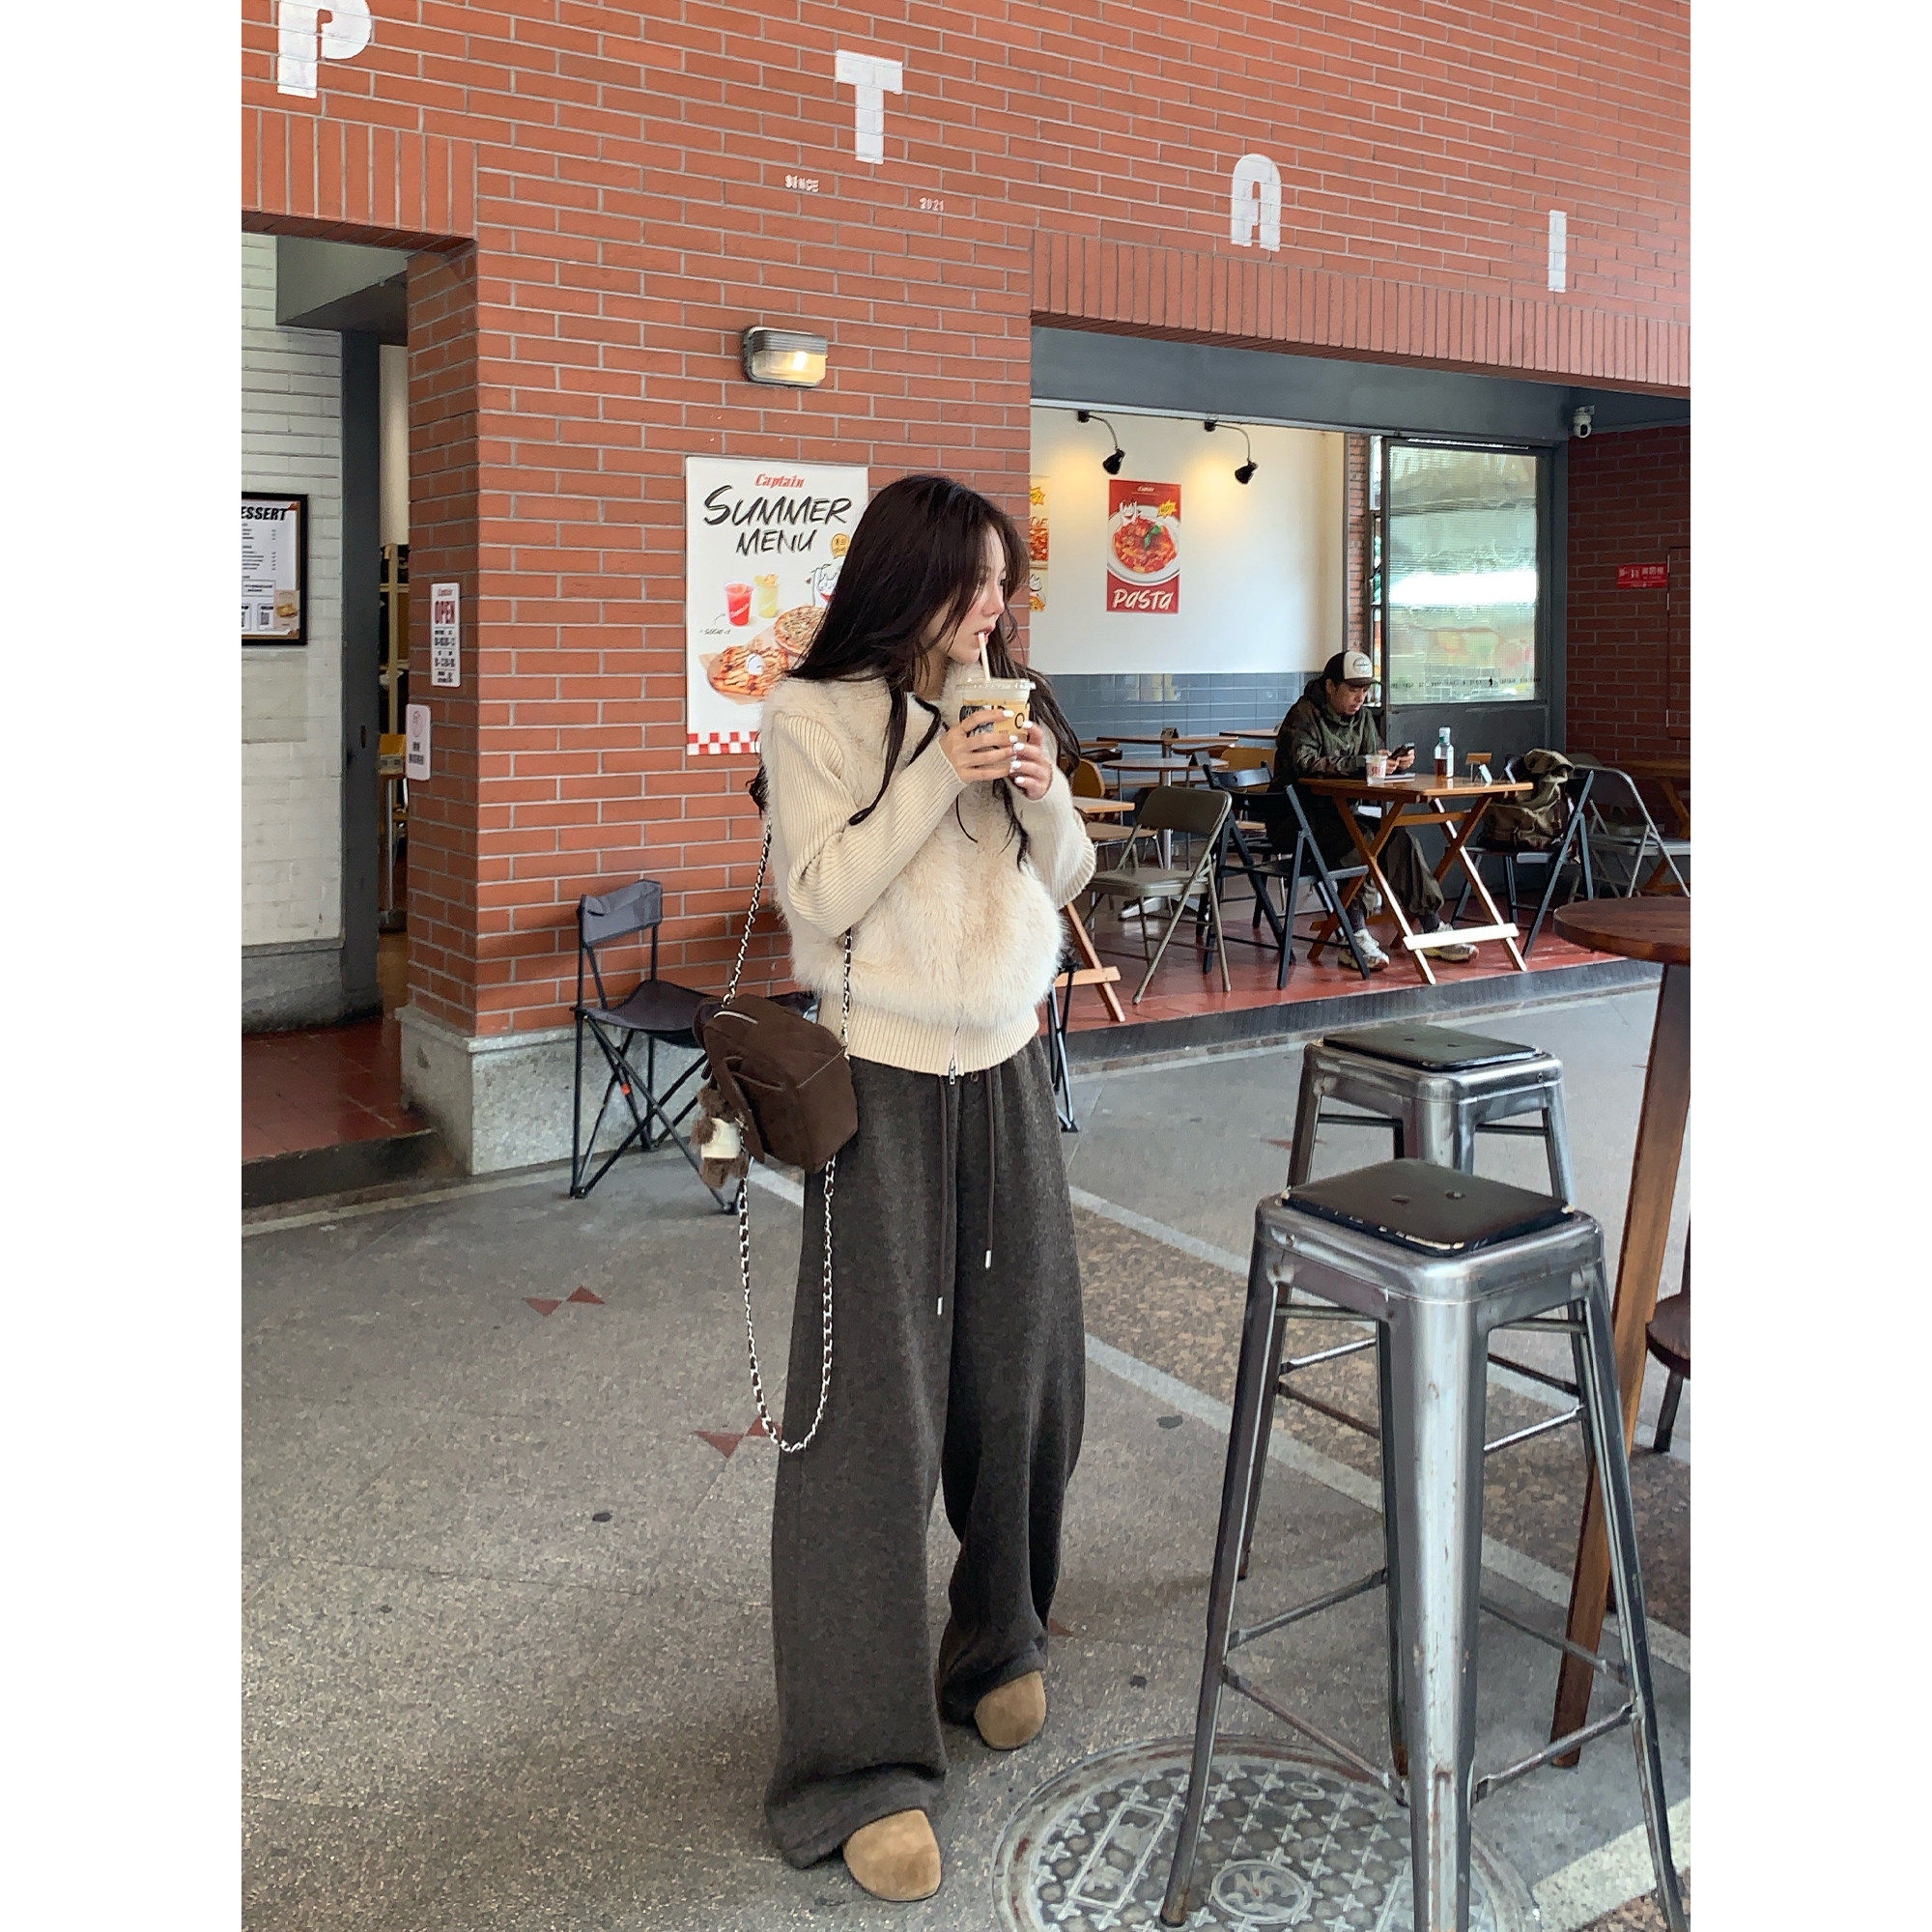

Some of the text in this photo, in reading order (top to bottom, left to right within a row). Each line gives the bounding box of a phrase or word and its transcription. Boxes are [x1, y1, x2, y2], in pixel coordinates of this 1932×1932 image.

[277, 0, 1568, 293] P T A I
[754, 473, 806, 489] Captain
[703, 485, 852, 526] SUMMER
[736, 528, 818, 556] MENU
